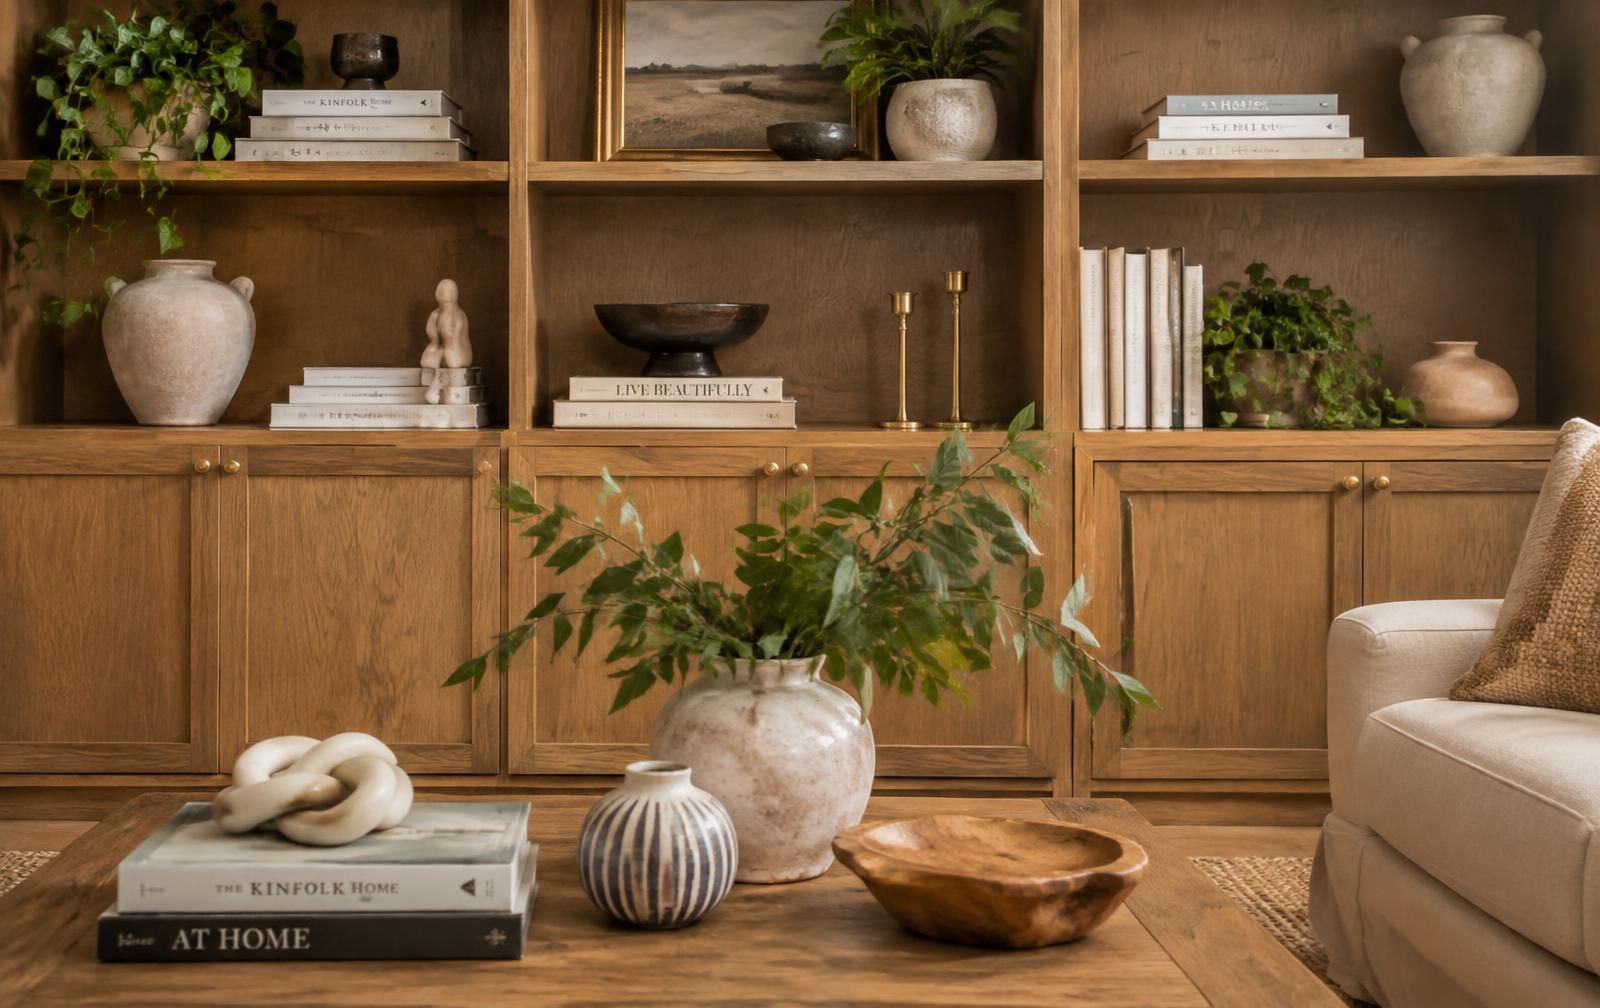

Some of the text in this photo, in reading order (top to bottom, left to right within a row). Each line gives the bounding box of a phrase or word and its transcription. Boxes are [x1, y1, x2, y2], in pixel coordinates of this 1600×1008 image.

[320, 98, 367, 107] KINFOLK
[616, 384, 752, 397] LIVE BEAUTIFULLY
[215, 882, 399, 896] THE KINFOLK HOME
[172, 928, 210, 950] AT
[218, 928, 310, 950] HOME
